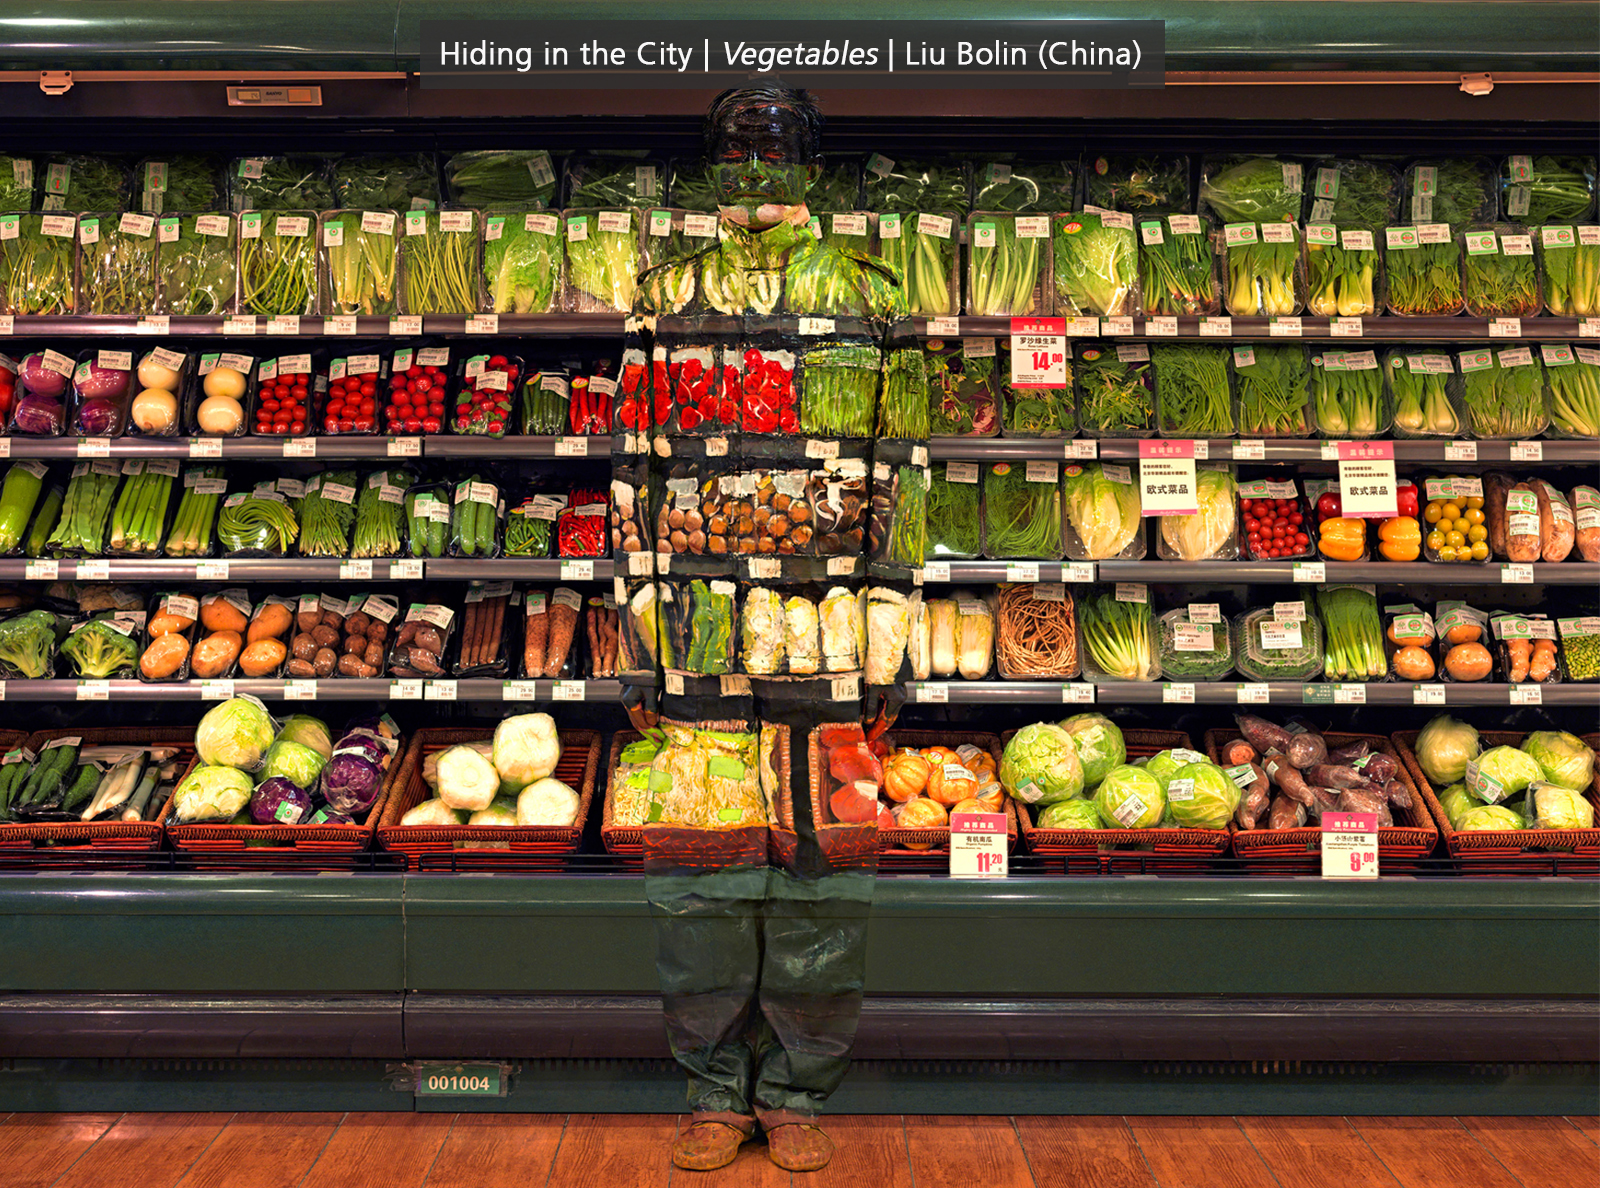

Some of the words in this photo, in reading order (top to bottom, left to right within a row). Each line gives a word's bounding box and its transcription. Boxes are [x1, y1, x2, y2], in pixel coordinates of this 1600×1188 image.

[1031, 351, 1063, 371] 14.00
[1146, 484, 1189, 495] 欧式菜品
[1349, 486, 1389, 496] 欧式菜品
[976, 852, 1003, 872] 11.20
[1350, 852, 1375, 872] 9.00
[428, 1075, 490, 1091] 001004
